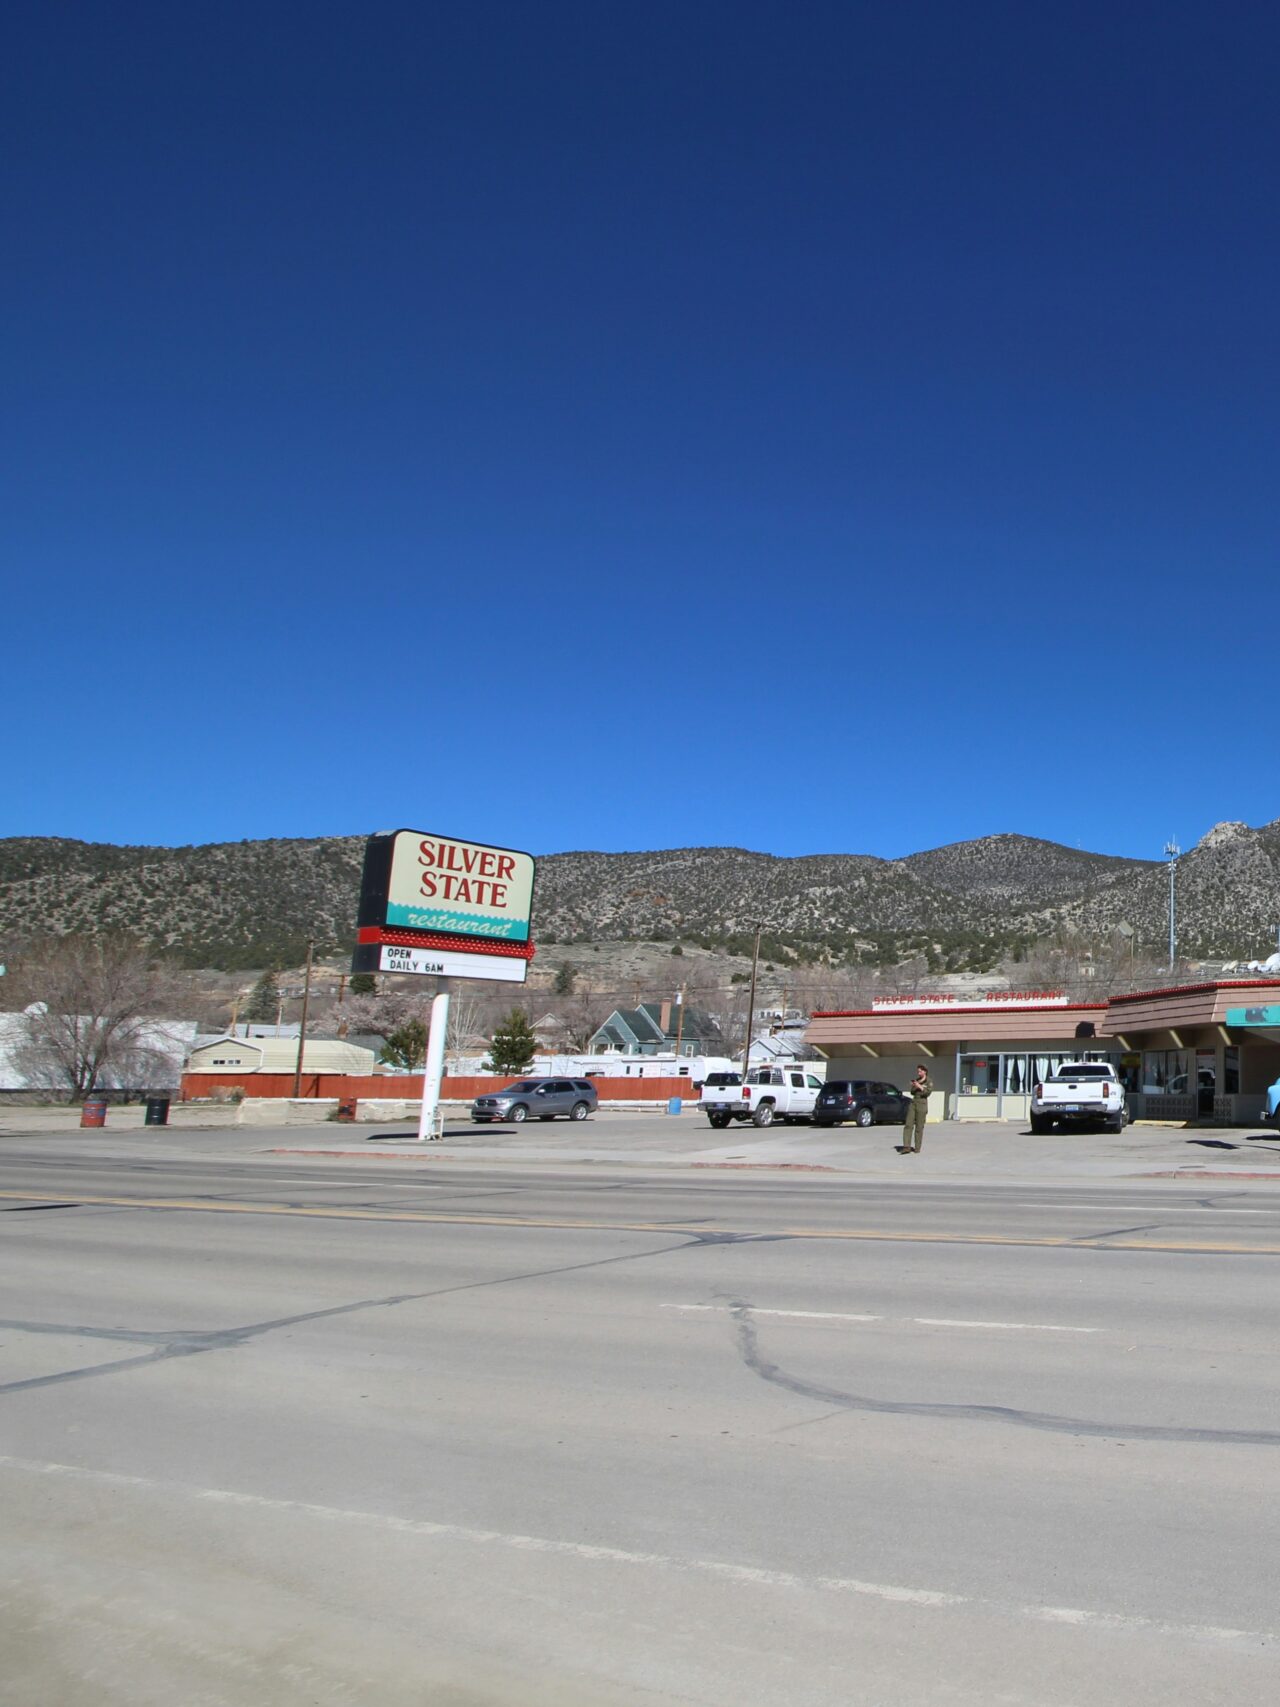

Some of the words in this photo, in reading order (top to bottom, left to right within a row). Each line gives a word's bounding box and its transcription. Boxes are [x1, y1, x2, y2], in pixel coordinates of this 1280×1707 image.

[418, 840, 516, 881] SILVER
[419, 871, 507, 908] STATE
[407, 912, 512, 937] restaurant
[387, 948, 412, 959] OPEN
[390, 960, 418, 971] DAILY
[425, 963, 444, 973] 6AM
[874, 995, 914, 1005] SILVER
[921, 994, 955, 1003] STATE
[986, 991, 1065, 1002] RESTAURANT
